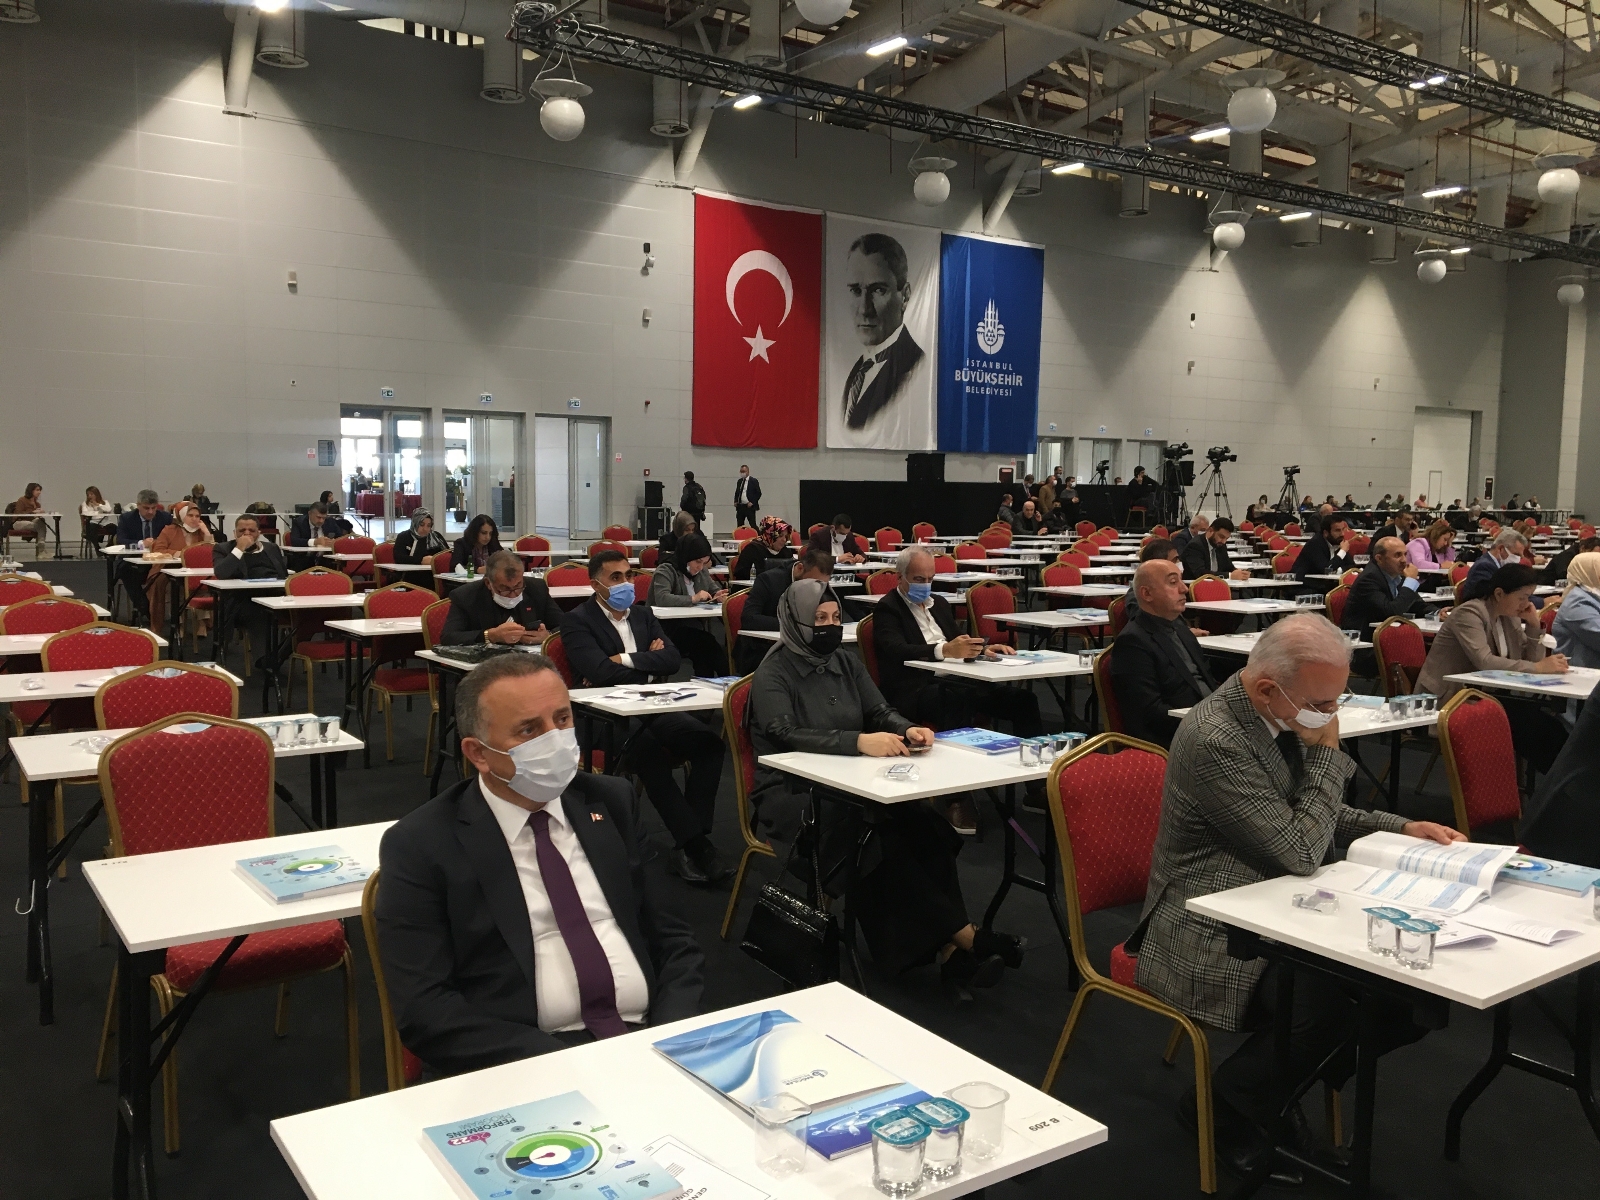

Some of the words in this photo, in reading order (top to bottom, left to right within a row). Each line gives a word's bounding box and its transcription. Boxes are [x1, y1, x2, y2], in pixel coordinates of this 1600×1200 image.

[966, 358, 1013, 370] İSTANBUL
[954, 367, 1023, 386] BÜYÜKŞEHİR
[965, 385, 1012, 396] BELEDİYESİ
[446, 1117, 517, 1139] PERFORMANS
[1028, 1121, 1050, 1132] 209
